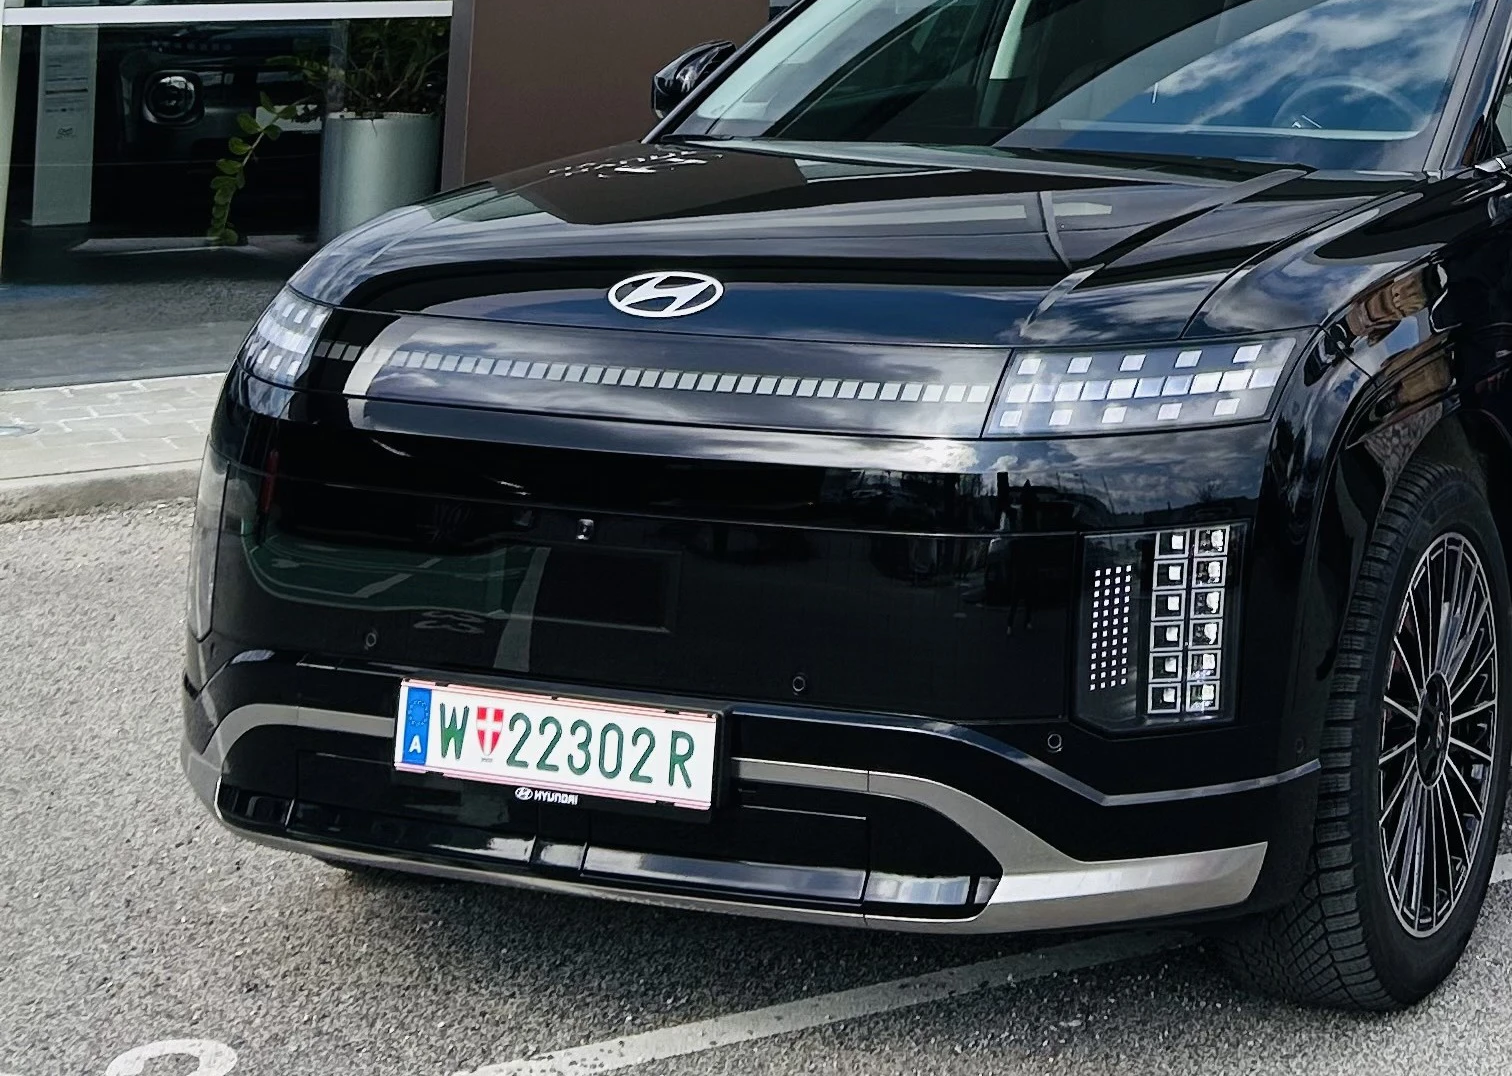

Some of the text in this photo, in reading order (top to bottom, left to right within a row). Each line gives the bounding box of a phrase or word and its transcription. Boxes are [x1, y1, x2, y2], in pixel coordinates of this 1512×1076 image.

[408, 735, 422, 754] A
[439, 701, 470, 760] W
[505, 712, 656, 784] 22302
[534, 790, 579, 806] HYUNDAI
